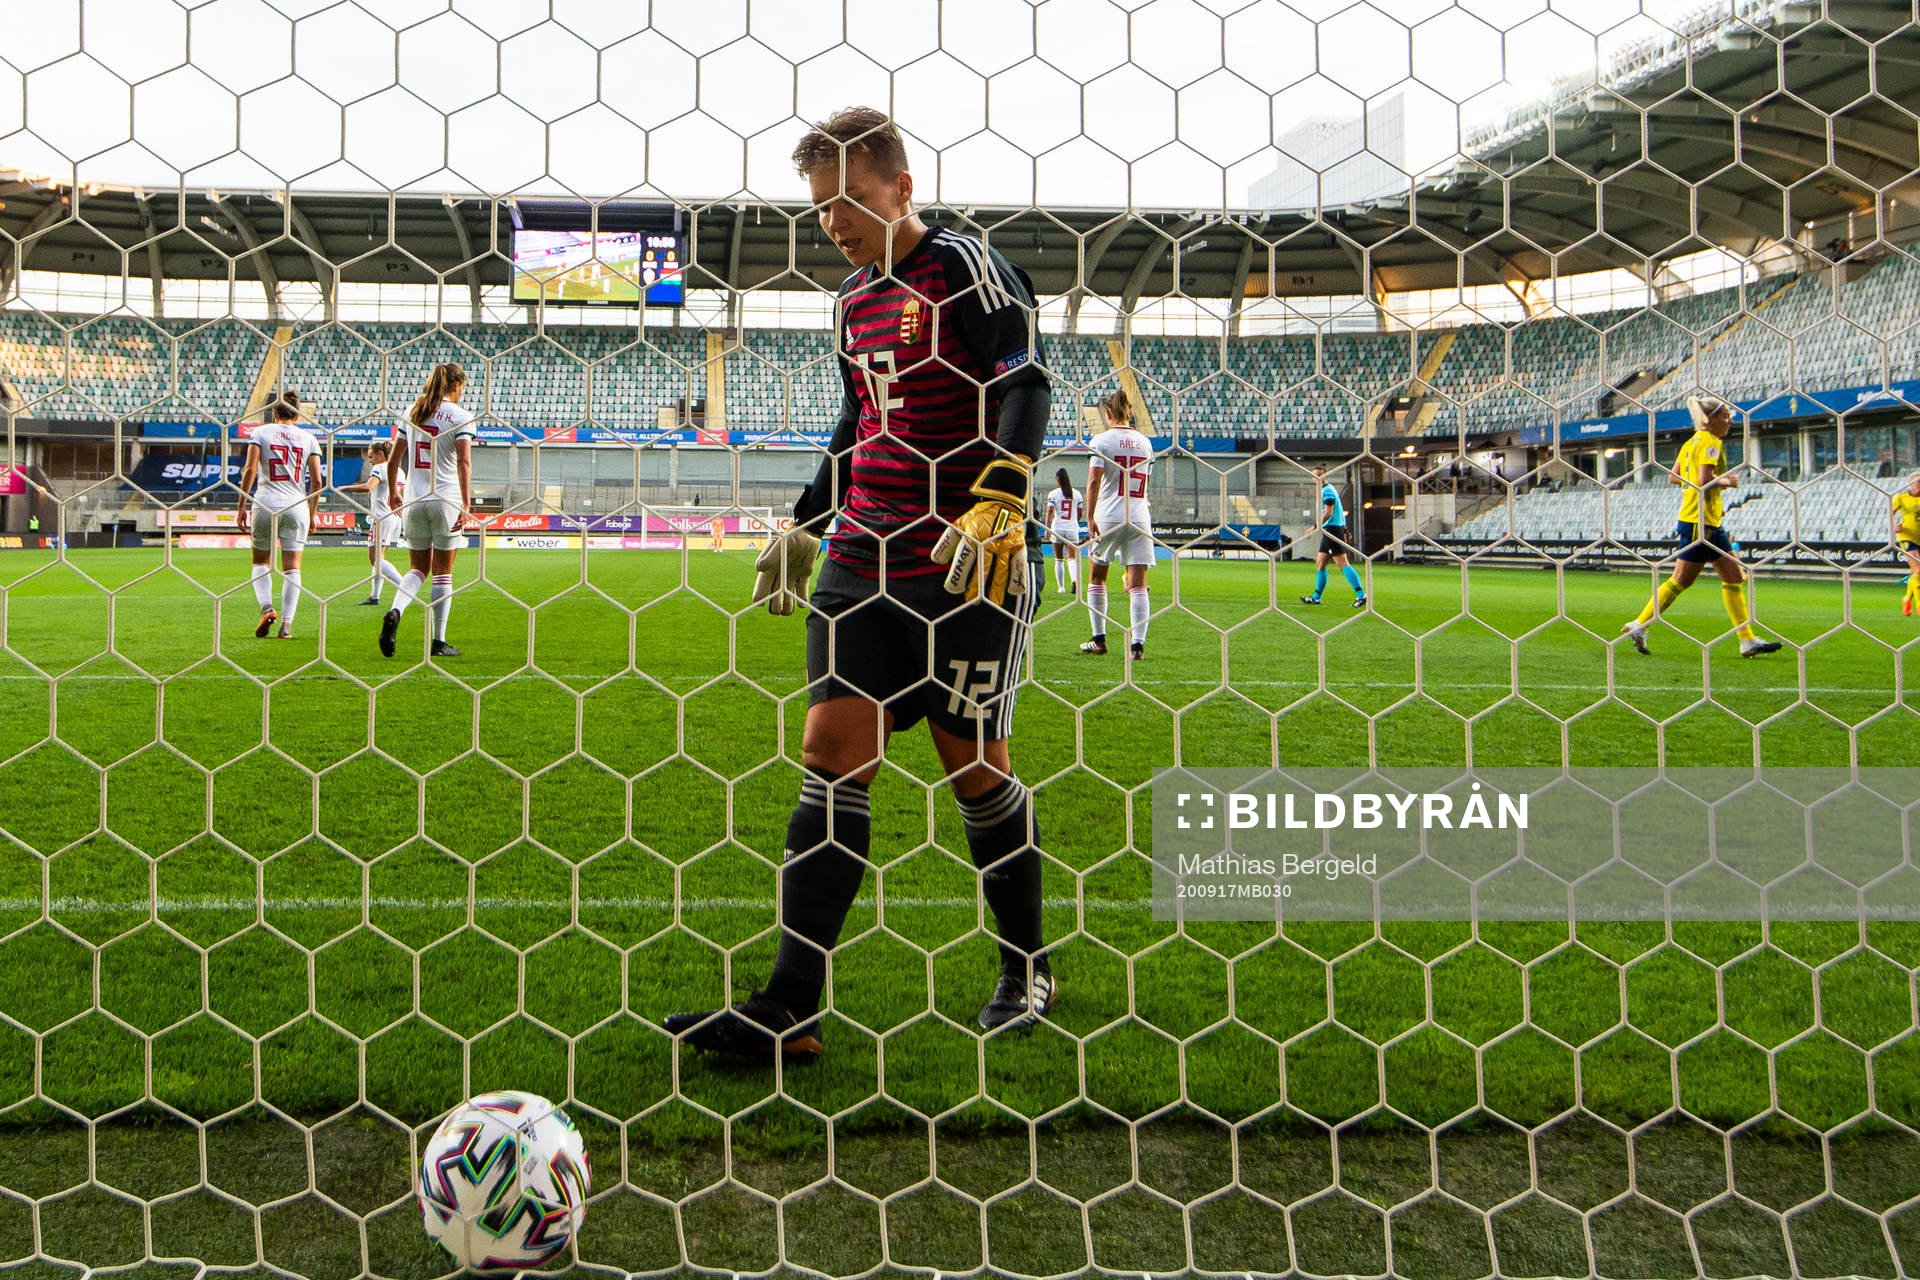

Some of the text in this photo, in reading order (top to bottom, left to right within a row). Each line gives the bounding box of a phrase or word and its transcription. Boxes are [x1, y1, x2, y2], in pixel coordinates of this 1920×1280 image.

[269, 444, 303, 483] 27
[1114, 455, 1147, 498] 15
[1061, 500, 1072, 520] 9
[503, 515, 542, 528] Estrella
[605, 519, 632, 530] Fabege
[516, 537, 560, 548] weber
[947, 659, 1000, 719] 12
